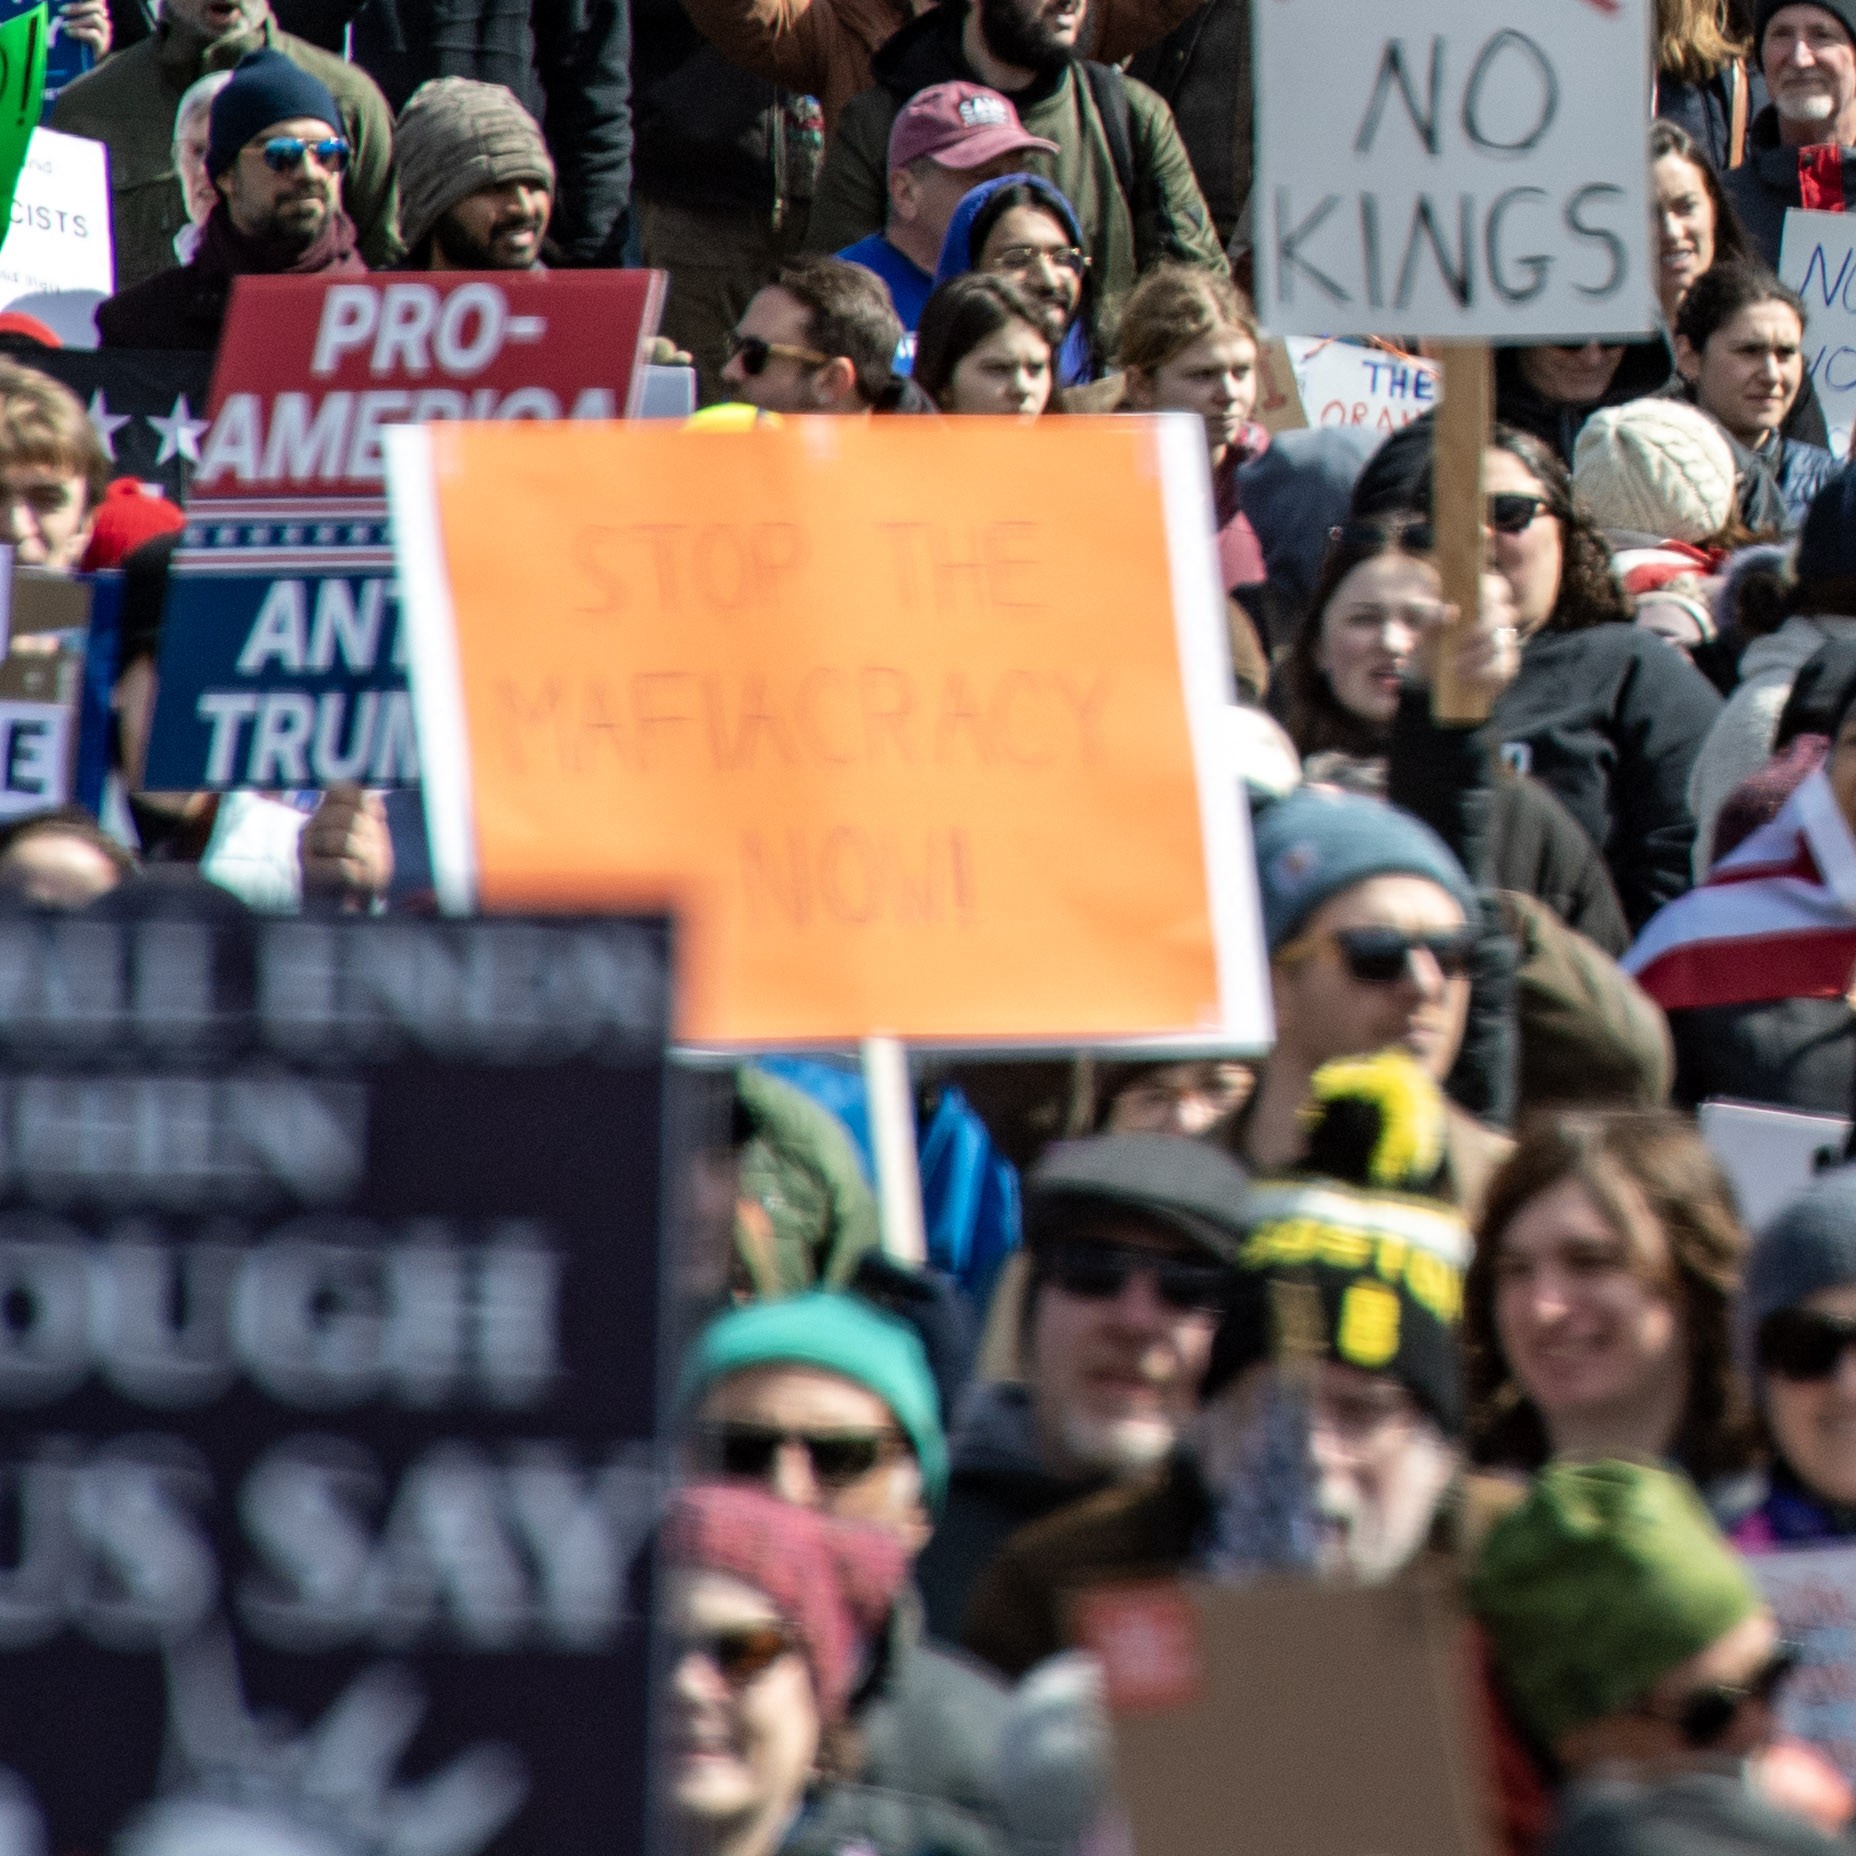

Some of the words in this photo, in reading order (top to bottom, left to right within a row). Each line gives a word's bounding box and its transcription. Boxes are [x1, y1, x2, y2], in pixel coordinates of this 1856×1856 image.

[1354, 26, 1559, 158] NO
[1271, 180, 1630, 310] KINGS
[310, 281, 550, 380] PRO-
[1362, 357, 1435, 401] THE
[570, 522, 813, 614] STOP
[872, 520, 1050, 612] THE
